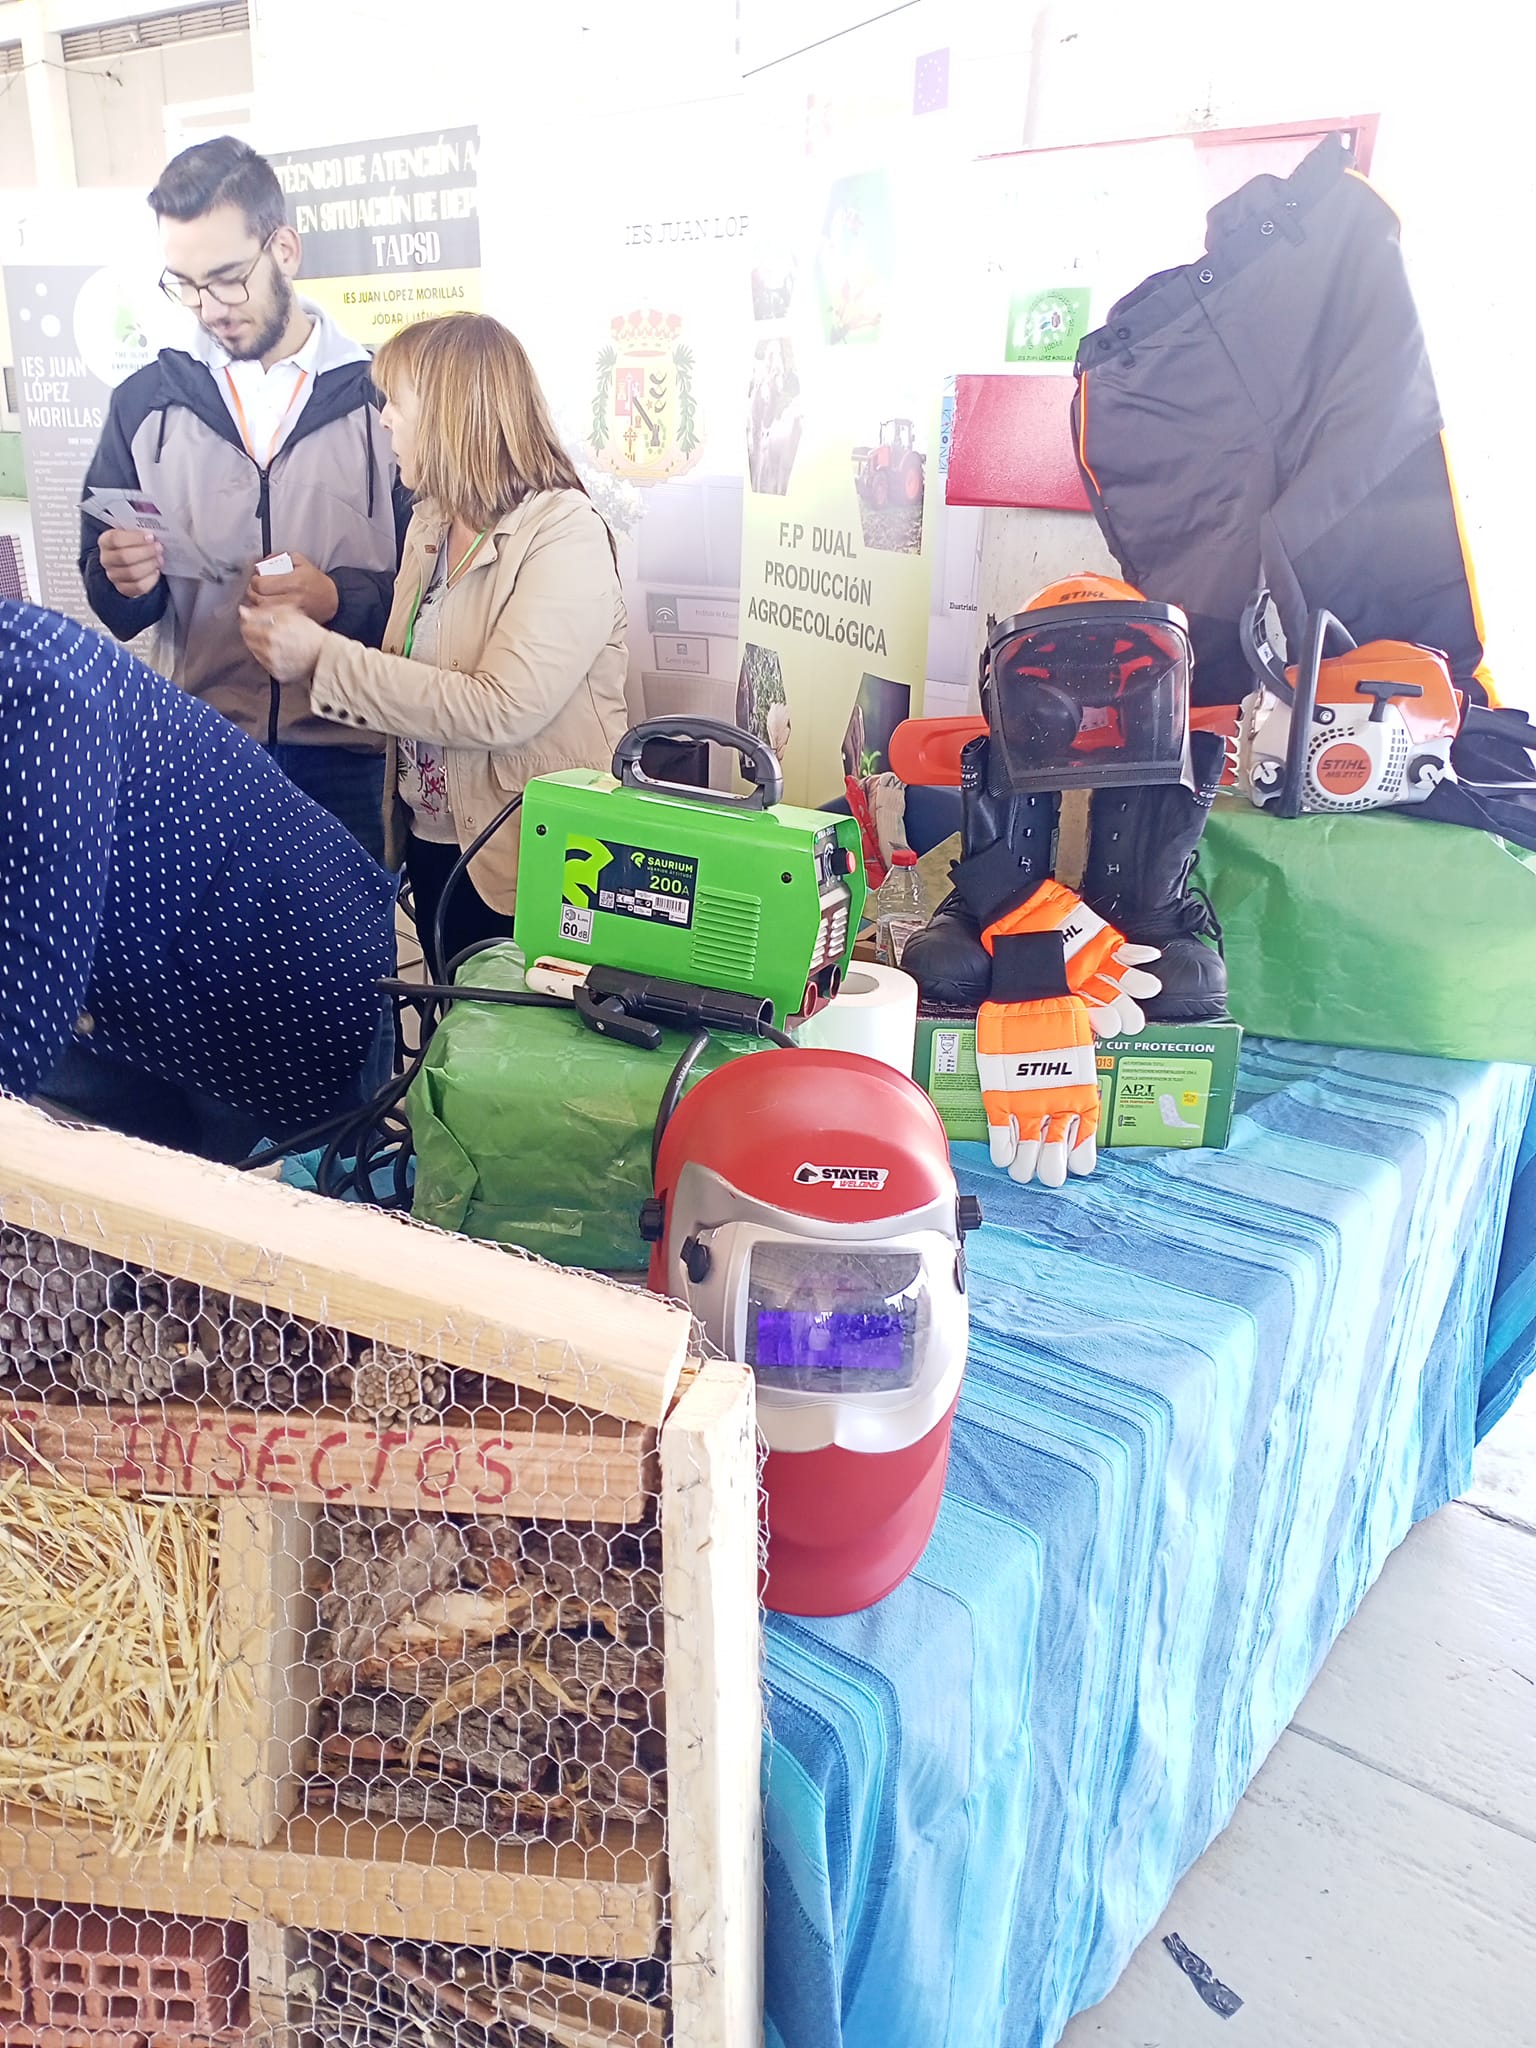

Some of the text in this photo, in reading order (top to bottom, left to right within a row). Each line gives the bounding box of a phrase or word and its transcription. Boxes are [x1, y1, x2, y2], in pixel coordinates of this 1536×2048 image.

[295, 204, 319, 234] EN
[412, 191, 438, 223] DE
[625, 224, 653, 246] IES
[658, 219, 708, 243] JUAN
[372, 231, 441, 267] TAPSD
[343, 293, 357, 304] IES
[358, 292, 381, 304] JUAN
[416, 286, 465, 301] MORILLAS
[21, 357, 87, 378] IES JUAN
[24, 375, 71, 403] LÓPEZ
[27, 406, 103, 428] MORILLAS
[779, 522, 857, 559] F.P DUAL
[1321, 760, 1368, 769] STIHL
[647, 857, 693, 873] SAURIUM
[563, 922, 588, 939] 60 dB
[1106, 1041, 1132, 1051] CUT
[1134, 1042, 1216, 1053] PROTECTION
[1016, 1062, 1073, 1076] STIHL
[822, 1168, 879, 1181] STAYER
[106, 1412, 514, 1504] INSECTOS
